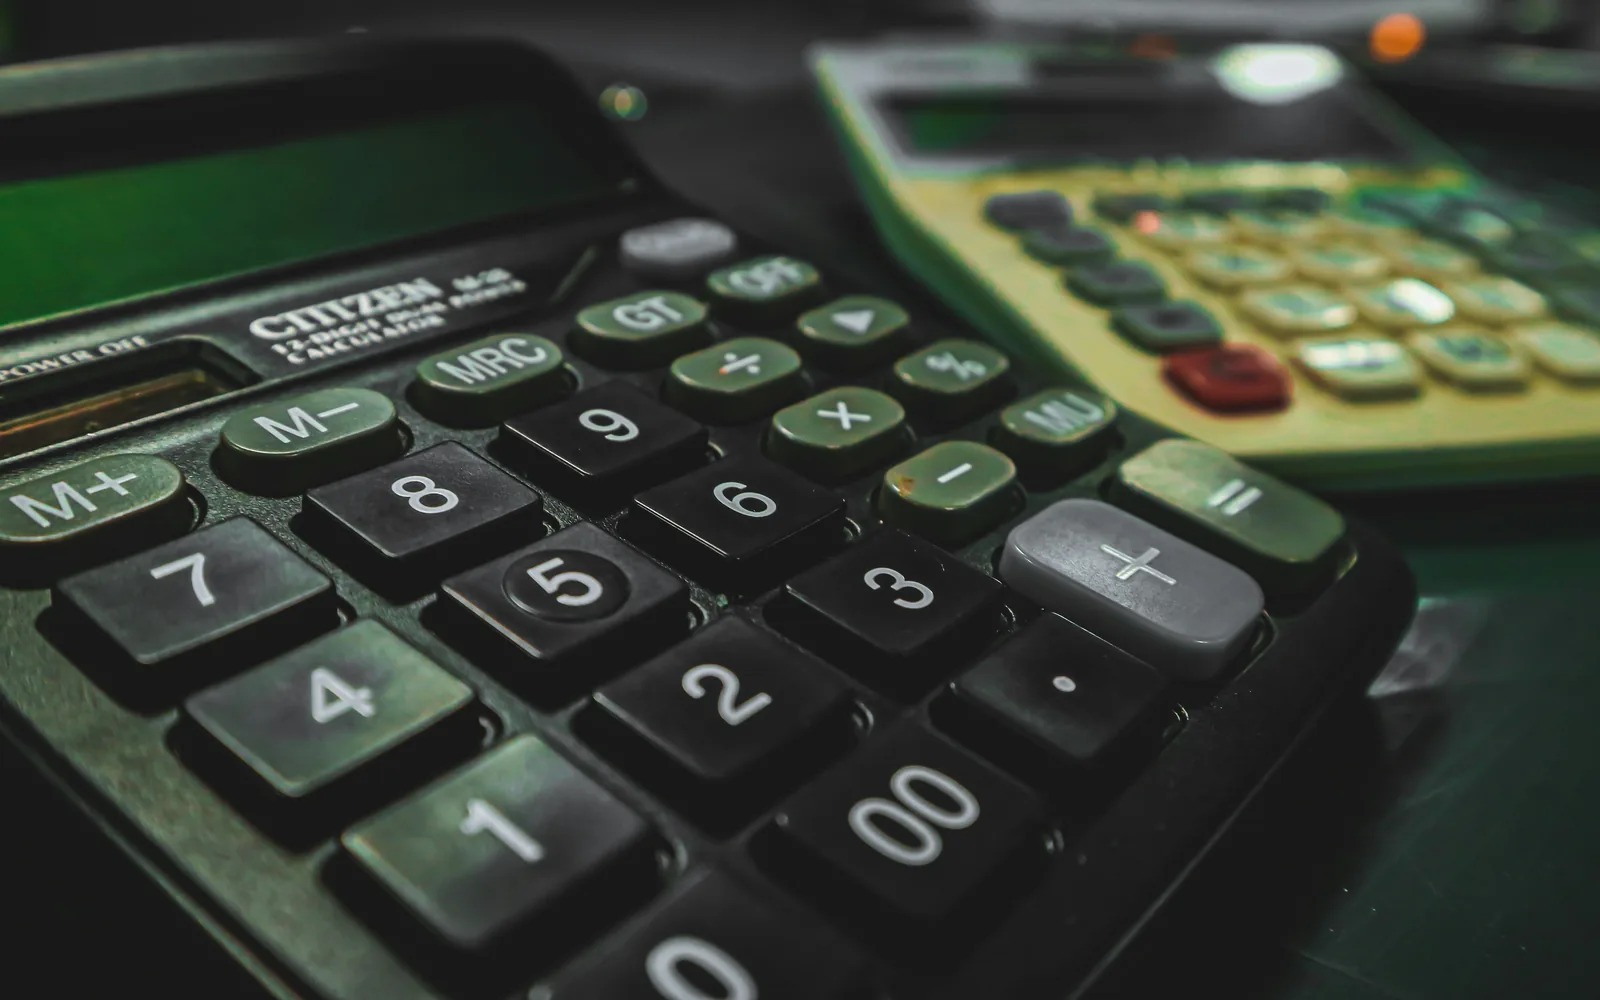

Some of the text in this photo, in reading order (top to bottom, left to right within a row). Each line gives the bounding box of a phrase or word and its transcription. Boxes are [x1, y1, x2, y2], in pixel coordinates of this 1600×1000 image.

[250, 278, 443, 340] CITIZEN
[611, 295, 684, 332] GT
[287, 314, 446, 365] CALCULATOR
[434, 336, 551, 386] MRC
[578, 408, 640, 443] 9
[1024, 392, 1106, 436] MU
[9, 470, 138, 528] M+
[390, 475, 460, 514] 8
[713, 481, 777, 519] 6
[150, 552, 215, 607] 7
[529, 557, 604, 608] 5
[863, 567, 934, 609] 3
[309, 668, 375, 723] 4
[681, 664, 773, 727] 2
[458, 799, 544, 864] 1
[847, 764, 980, 866] 00
[645, 936, 757, 1000] 0
